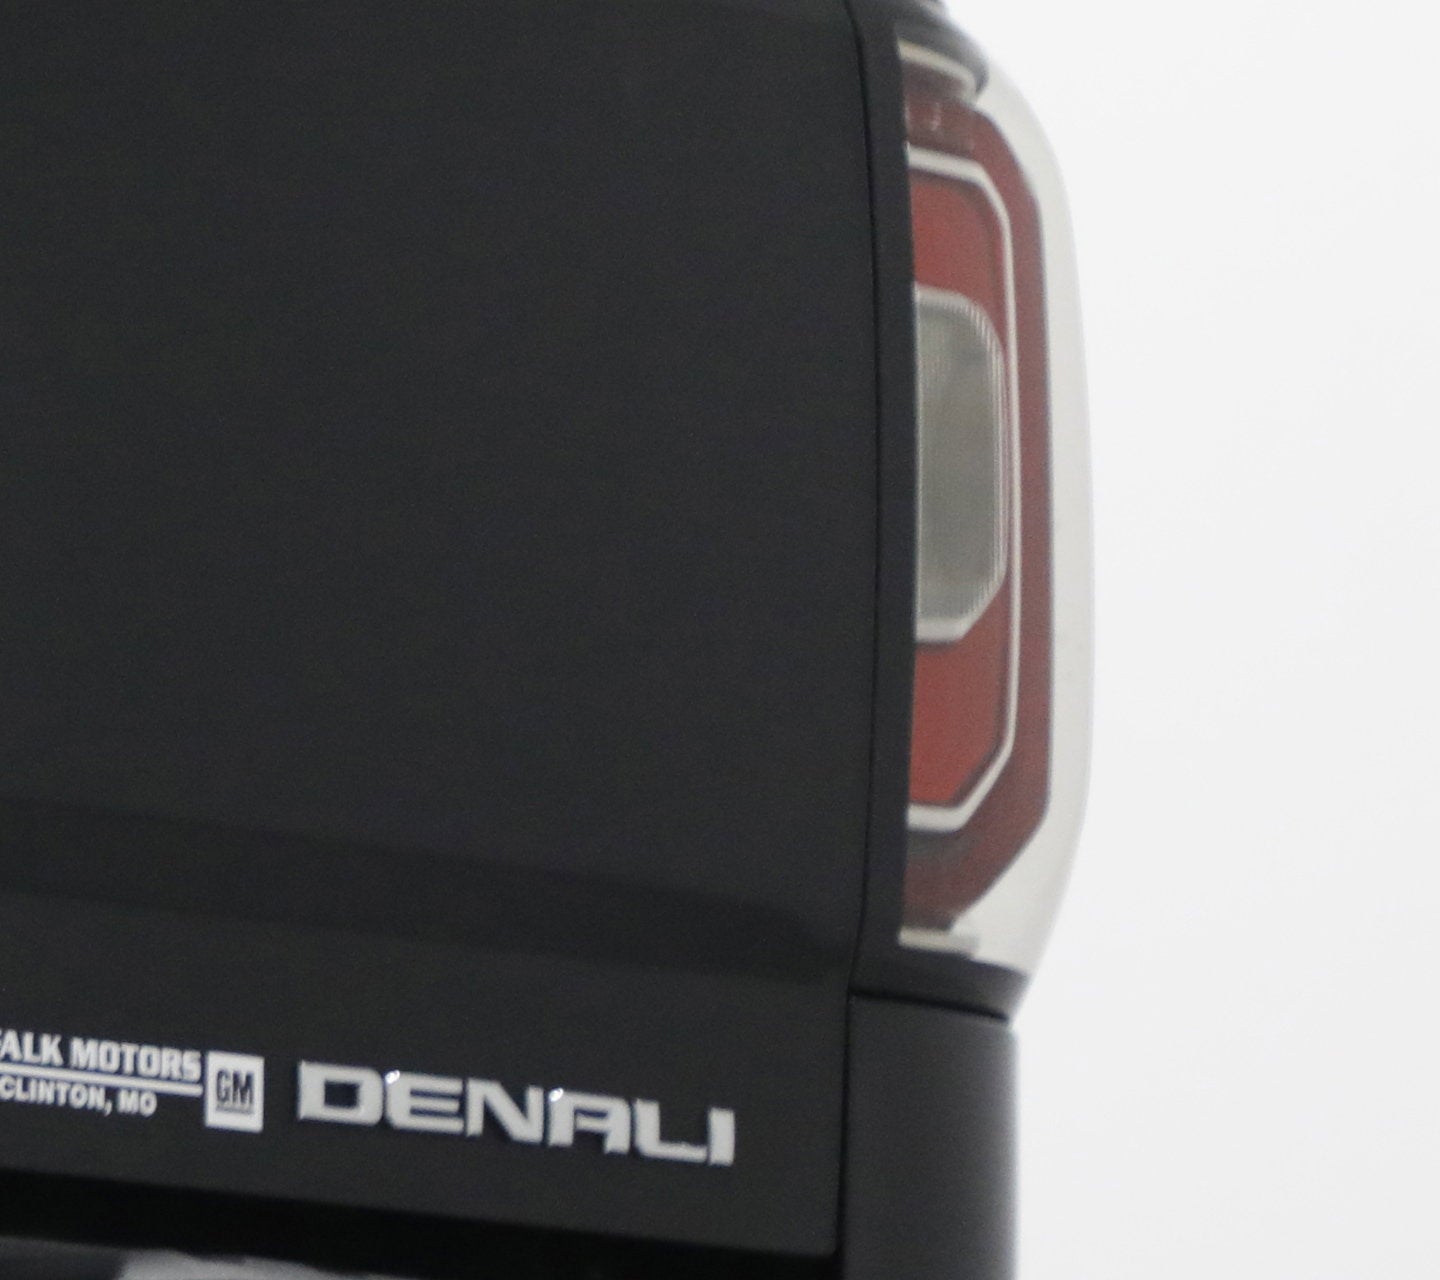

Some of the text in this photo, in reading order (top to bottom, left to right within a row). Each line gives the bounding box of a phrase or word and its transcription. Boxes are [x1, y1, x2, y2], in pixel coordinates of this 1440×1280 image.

[70, 1037, 203, 1083] MOTORS
[118, 1089, 158, 1117] MO
[215, 1069, 255, 1106] GM
[298, 1059, 736, 1166] DENALI
